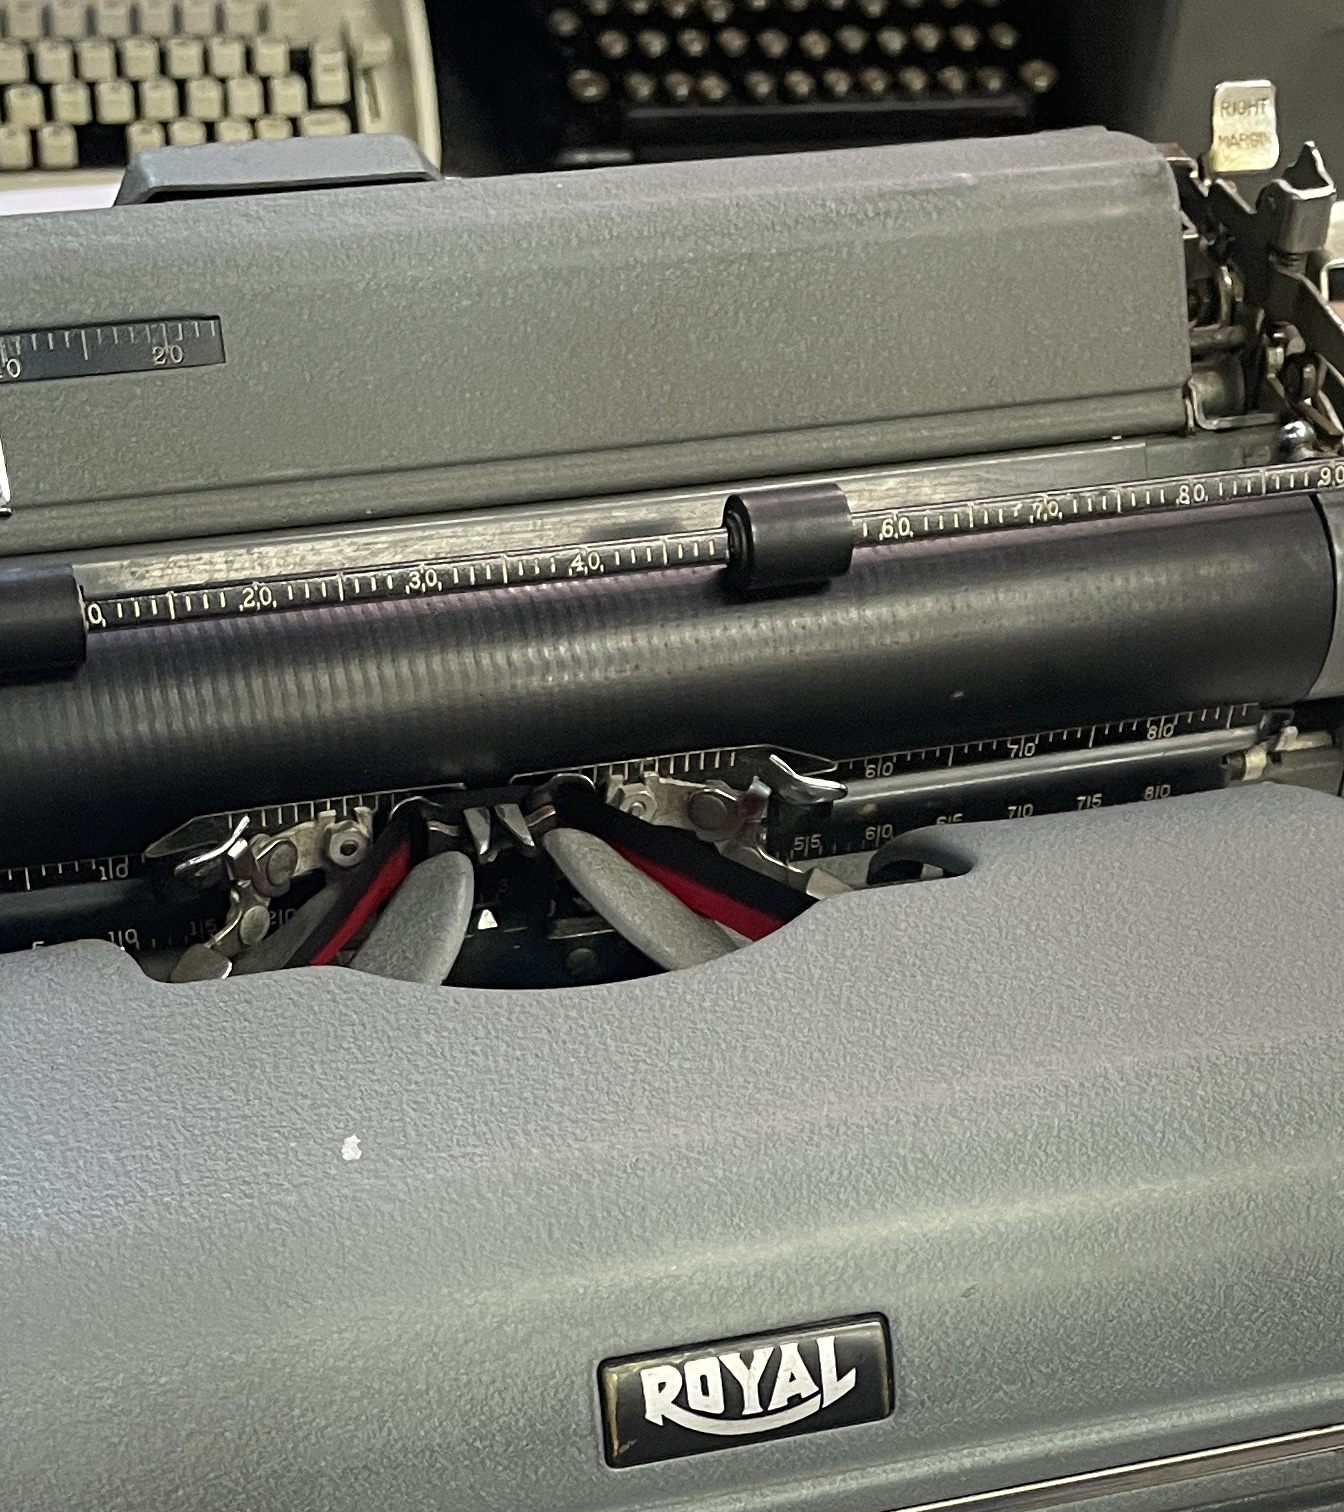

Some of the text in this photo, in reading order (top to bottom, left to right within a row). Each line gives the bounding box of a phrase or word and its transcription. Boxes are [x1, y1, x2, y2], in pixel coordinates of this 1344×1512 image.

[1221, 97, 1269, 117] RIGHT
[152, 345, 184, 366] 20
[242, 586, 272, 607] 20
[408, 568, 438, 589] 30
[571, 551, 601, 572] 40
[881, 517, 911, 538] 60
[1032, 499, 1059, 519] 70
[1178, 482, 1205, 503] 80
[865, 762, 893, 779] 60
[1007, 742, 1035, 758] 70
[1147, 724, 1175, 740] 80
[793, 834, 821, 850] 55
[865, 824, 893, 840] 60
[1008, 804, 1033, 819] 70
[1077, 793, 1102, 810] 75
[1144, 785, 1171, 801] 80
[640, 1336, 856, 1435] ROYAL
